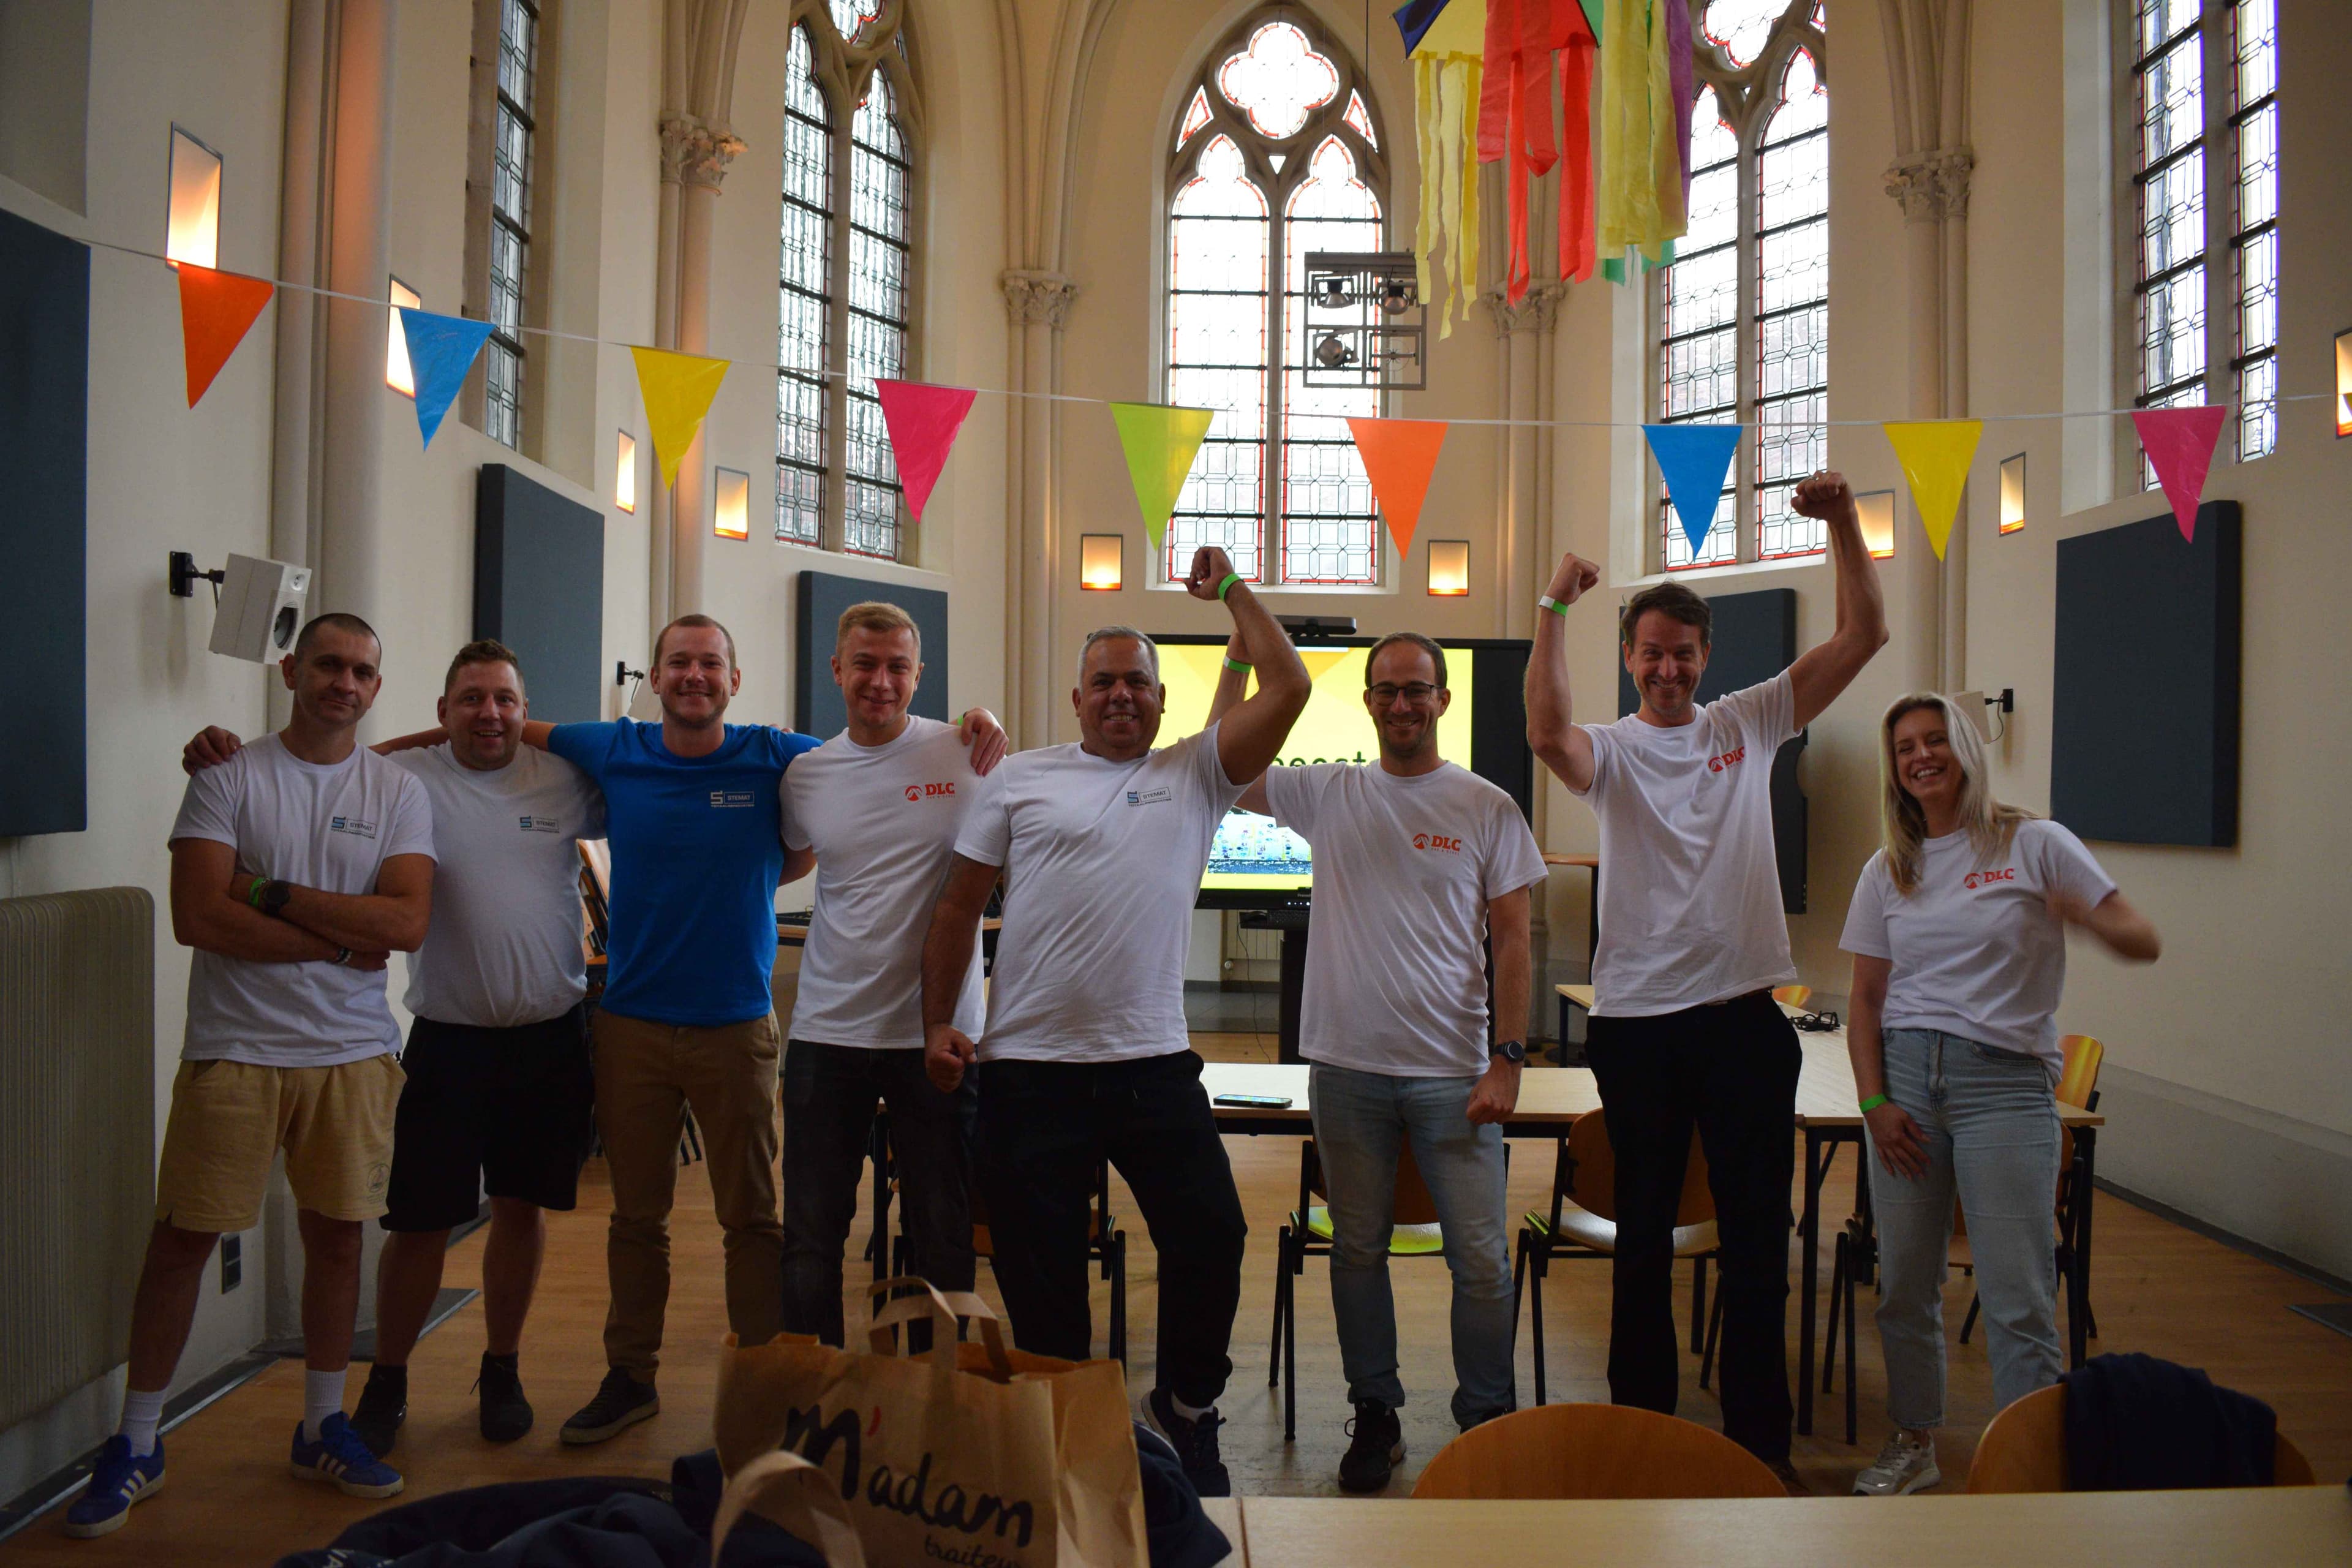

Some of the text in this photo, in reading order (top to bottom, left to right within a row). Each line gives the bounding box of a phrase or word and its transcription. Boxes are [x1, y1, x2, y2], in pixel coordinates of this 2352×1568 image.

[1722, 746, 1744, 766] DLC
[925, 782, 955, 796] DLC
[1143, 790, 1167, 799] STEMAT
[1431, 835, 1461, 851] DLC
[1984, 868, 2015, 883] DLC
